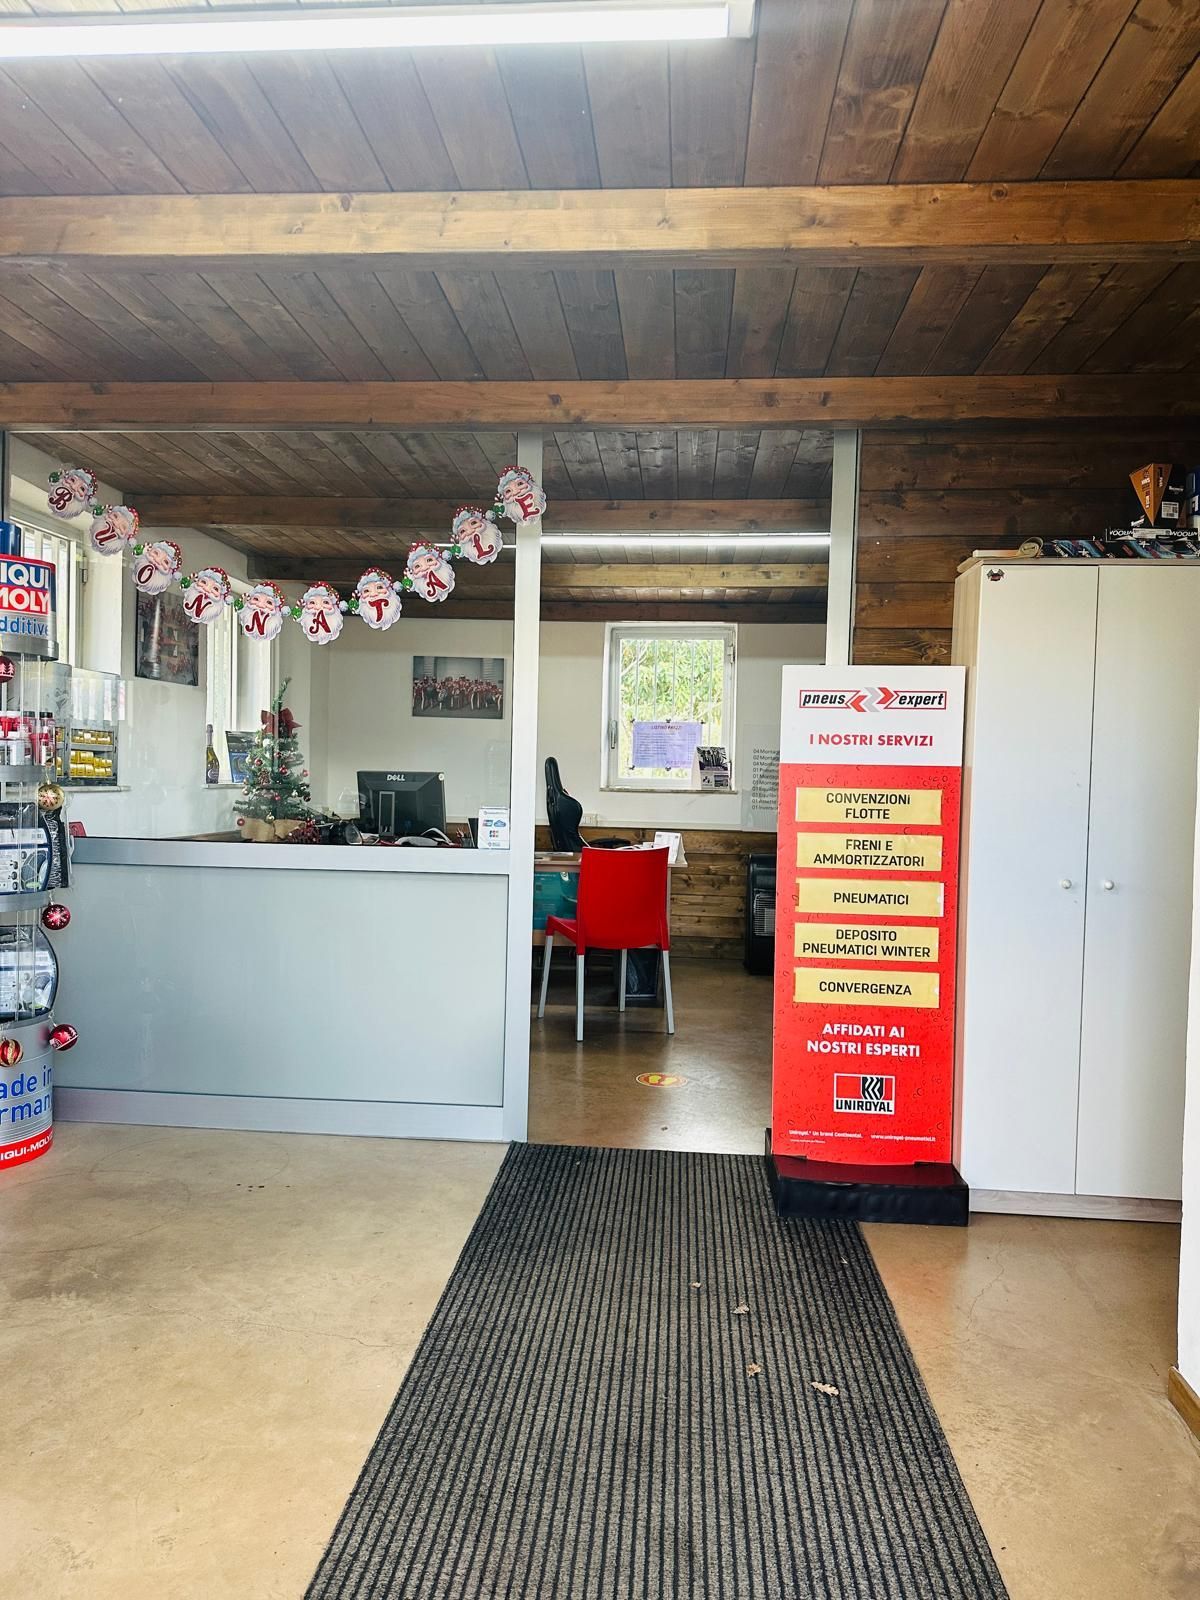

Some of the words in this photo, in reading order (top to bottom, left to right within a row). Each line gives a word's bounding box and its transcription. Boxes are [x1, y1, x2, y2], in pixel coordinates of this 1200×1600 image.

[802, 692, 846, 707] pneus
[898, 693, 944, 708] expert
[809, 734, 813, 745] I
[818, 734, 873, 746] NOSTRI
[878, 735, 933, 747] SERVIZI
[386, 774, 405, 782] DELL
[826, 792, 911, 806] CONVENZIONI
[845, 808, 890, 820] FLOTTE
[845, 839, 881, 851] FRENI
[885, 840, 893, 852] E
[813, 854, 925, 868] AMMORTIZZATORI
[833, 892, 909, 906] PNEUMATICI
[835, 929, 897, 942] DEPOSITO
[802, 943, 877, 956] PNEUMATICI
[881, 945, 931, 958] WINTER
[818, 981, 912, 996] CONVERGENZA
[822, 1023, 885, 1037] AFFIDATI
[889, 1025, 905, 1038] AI
[806, 1041, 862, 1054] NOSTRI
[866, 1043, 920, 1057] ESPERTI
[835, 1099, 893, 1113] UNIROYAL
